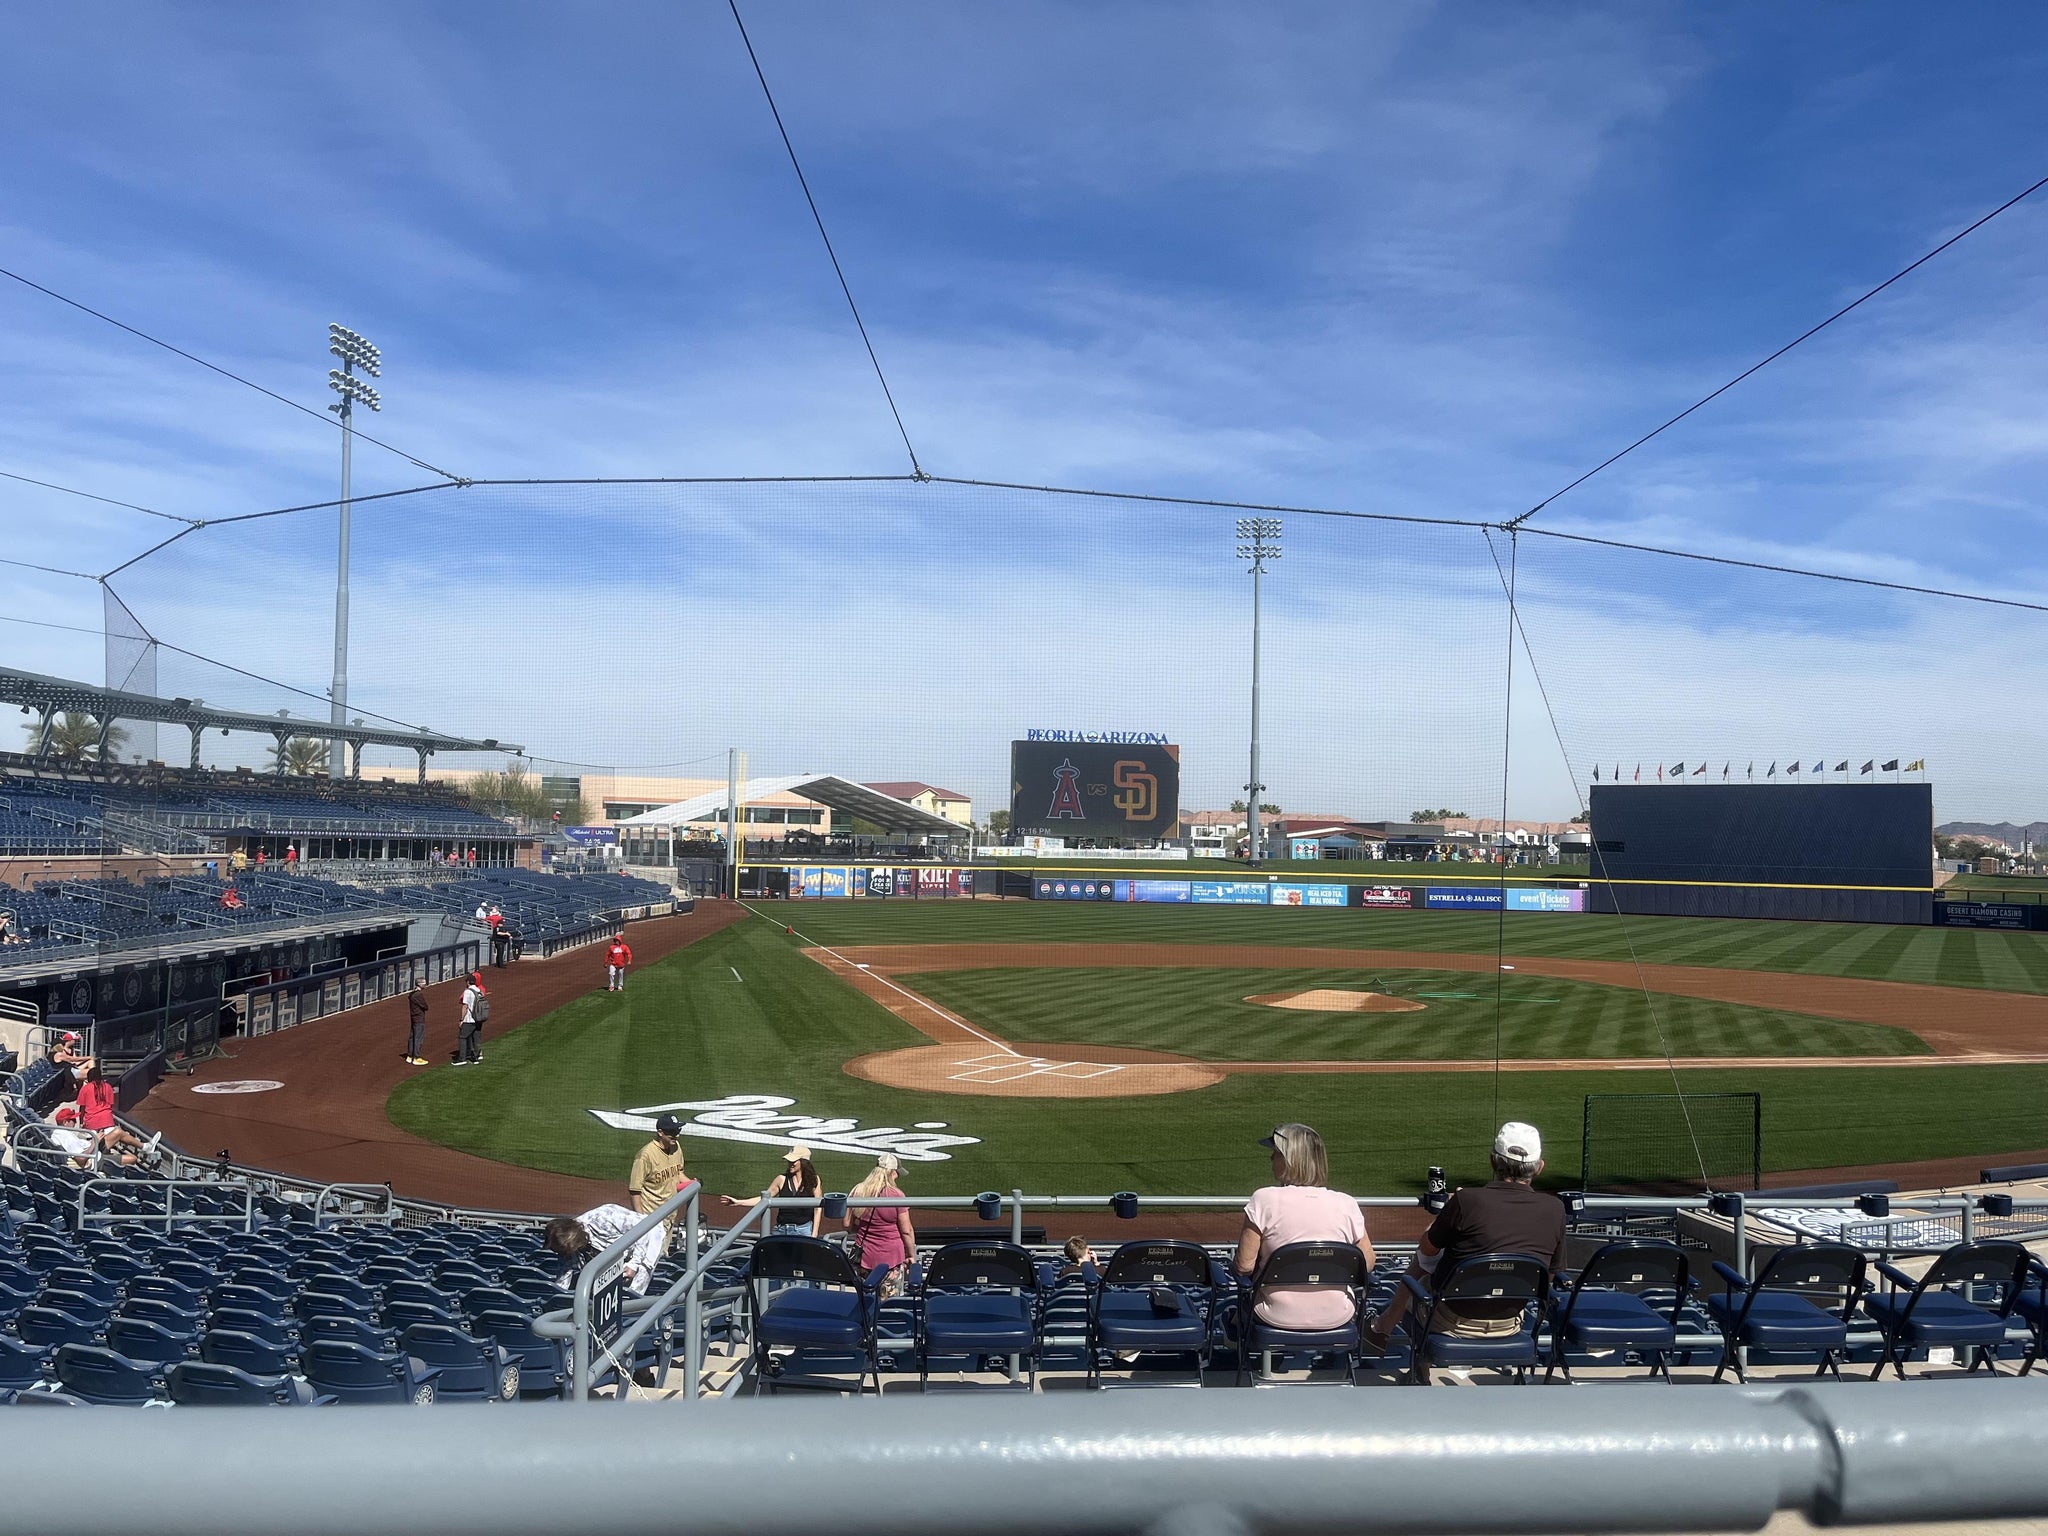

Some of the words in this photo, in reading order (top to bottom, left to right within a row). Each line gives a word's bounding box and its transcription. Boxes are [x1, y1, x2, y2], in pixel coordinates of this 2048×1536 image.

[1027, 729, 1083, 742] PEORIA
[1096, 731, 1169, 745] ARIZONA
[897, 874, 912, 882] KILT
[918, 868, 953, 883] KILT
[958, 874, 973, 882] KILT
[1429, 894, 1466, 902] ESTRELLA
[1473, 895, 1503, 903] JALISCO
[1520, 895, 1540, 904] event
[1547, 893, 1570, 904] tickets
[1946, 906, 1969, 915] DESERT
[1970, 907, 1998, 917] DIAMOND
[1999, 909, 2023, 917] CASINO
[655, 1168, 670, 1184] SAN
[597, 1261, 622, 1288] SECTION
[600, 1285, 618, 1326] 104
